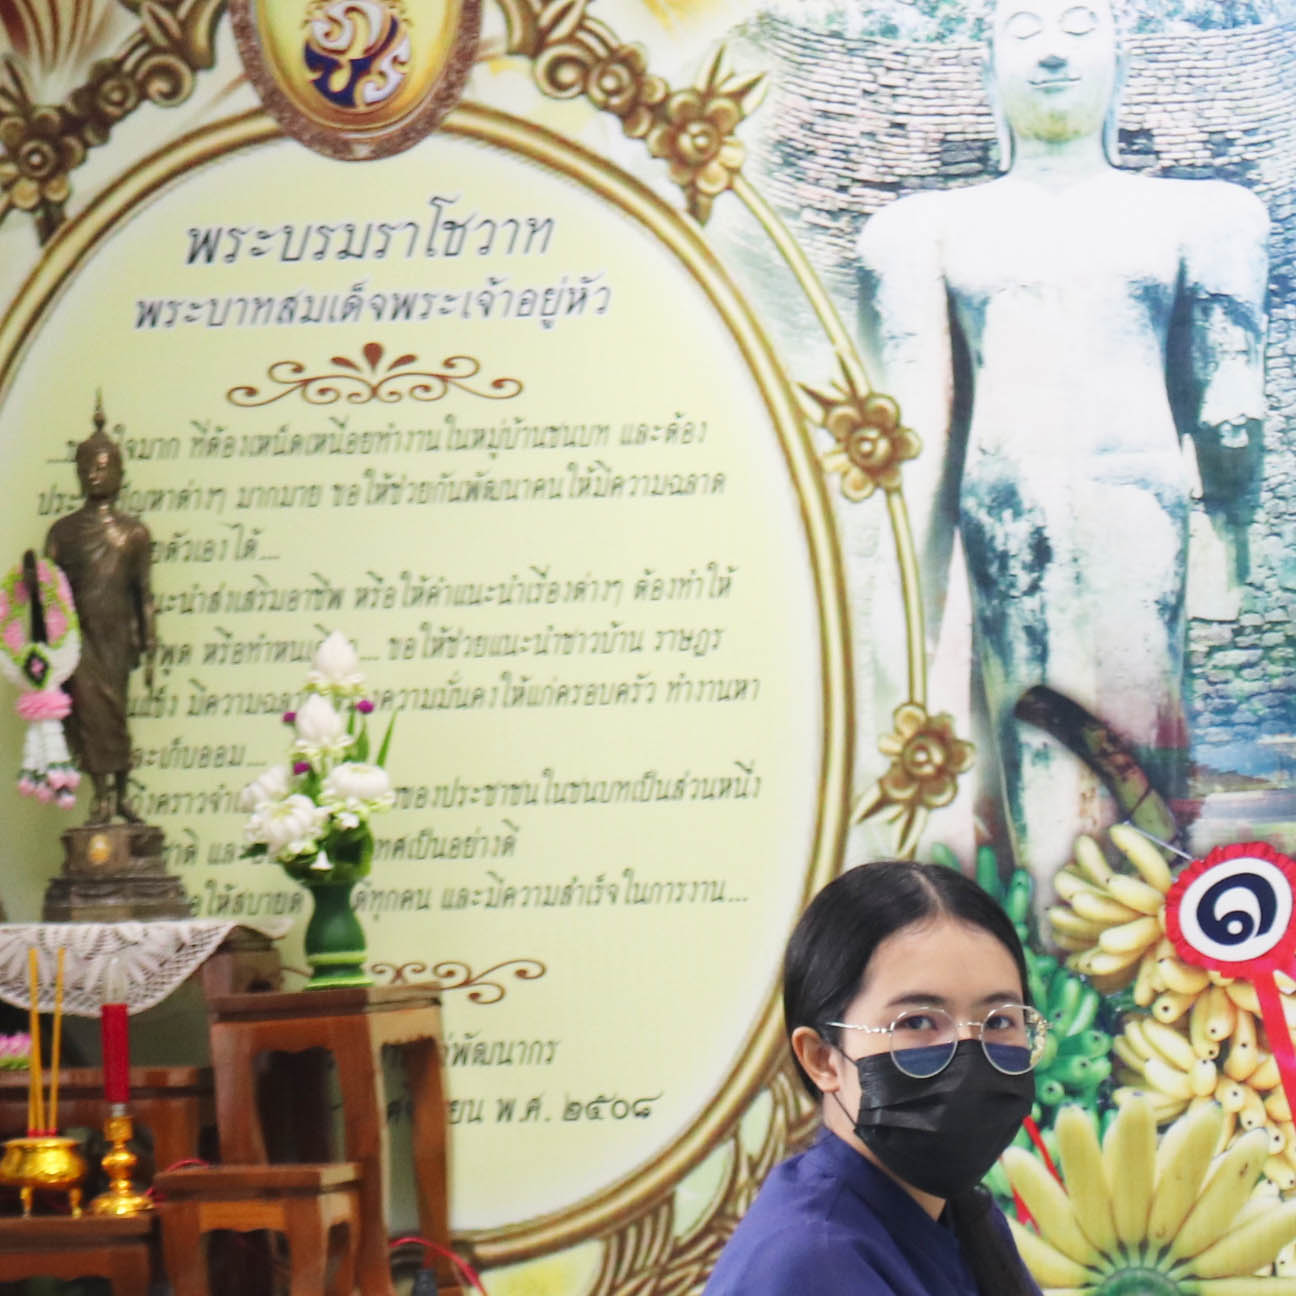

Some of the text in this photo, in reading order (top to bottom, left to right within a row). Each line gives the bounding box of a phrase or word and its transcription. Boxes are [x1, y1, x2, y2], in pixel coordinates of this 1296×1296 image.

[186, 196, 555, 265] พระบรมราโชวาท
[135, 275, 612, 329] พระบาทสมเด็จพระเจ้าอยู่หัว
[561, 1090, 663, 1123] ๒๕๐๘
